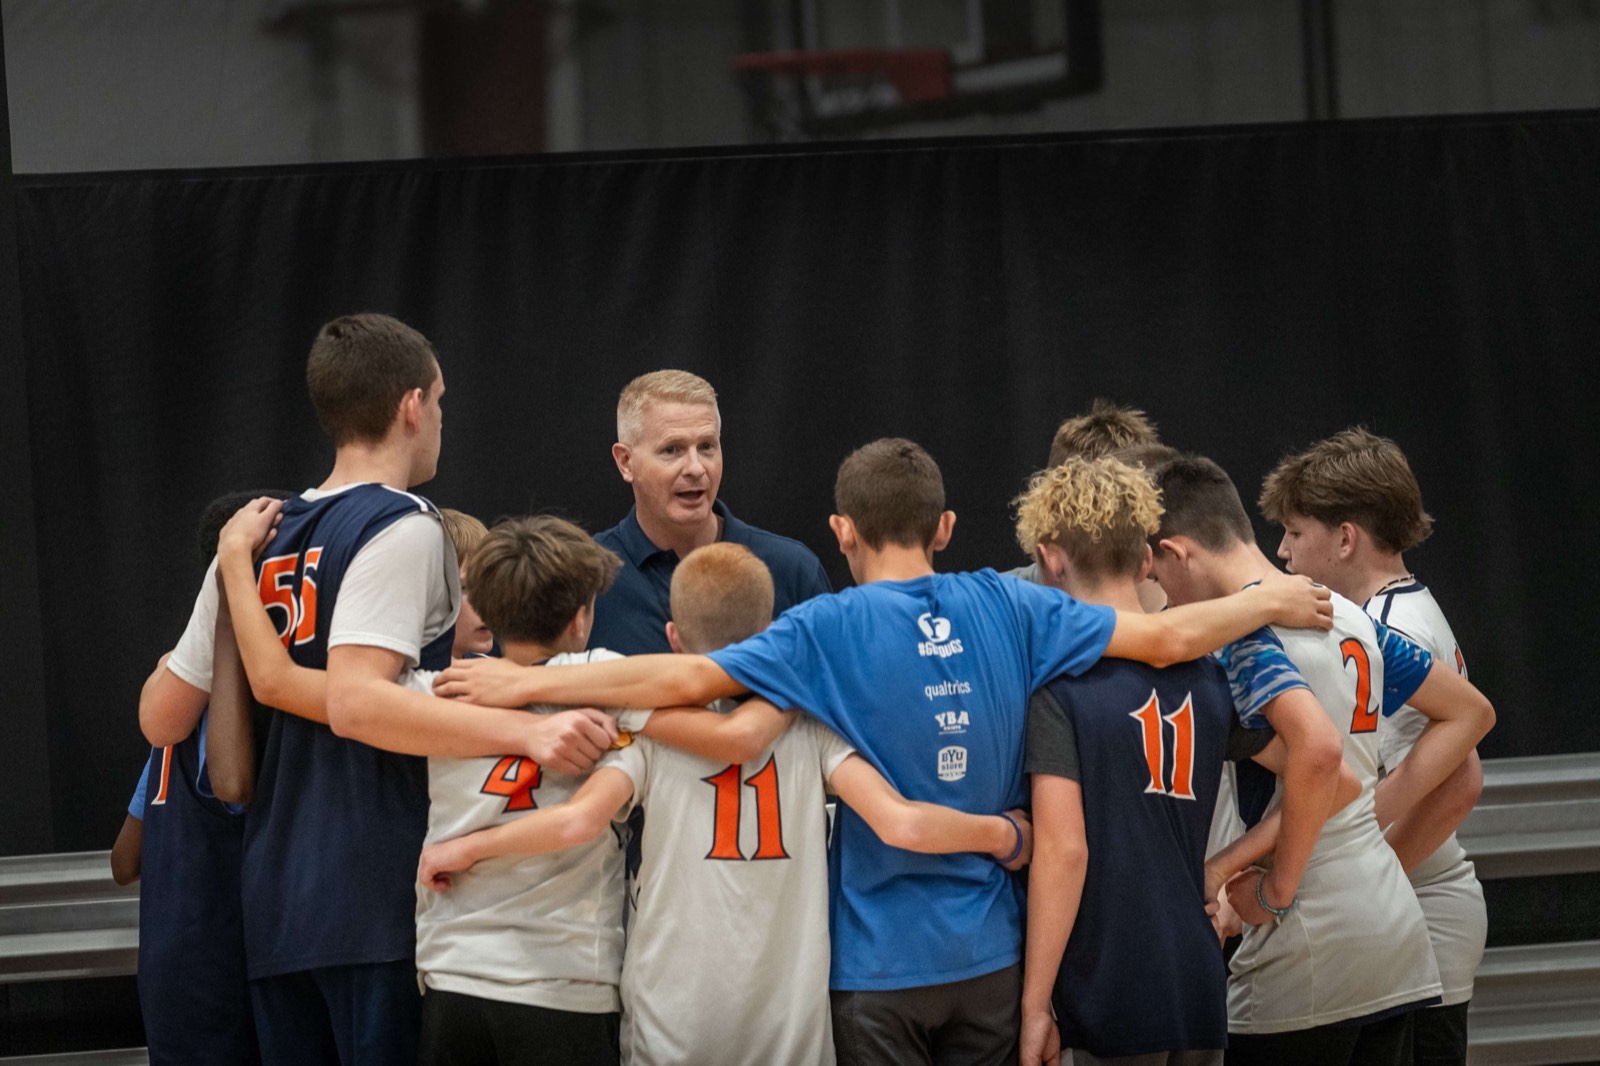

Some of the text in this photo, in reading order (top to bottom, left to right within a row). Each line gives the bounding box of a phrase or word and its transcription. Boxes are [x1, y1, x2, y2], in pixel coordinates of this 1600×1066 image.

[1339, 637, 1379, 734] 2
[934, 710, 970, 727] YBA
[1128, 687, 1197, 801] 11
[480, 754, 543, 814] 4
[941, 749, 963, 762] BYU
[941, 762, 963, 770] store
[700, 751, 792, 861] 11
